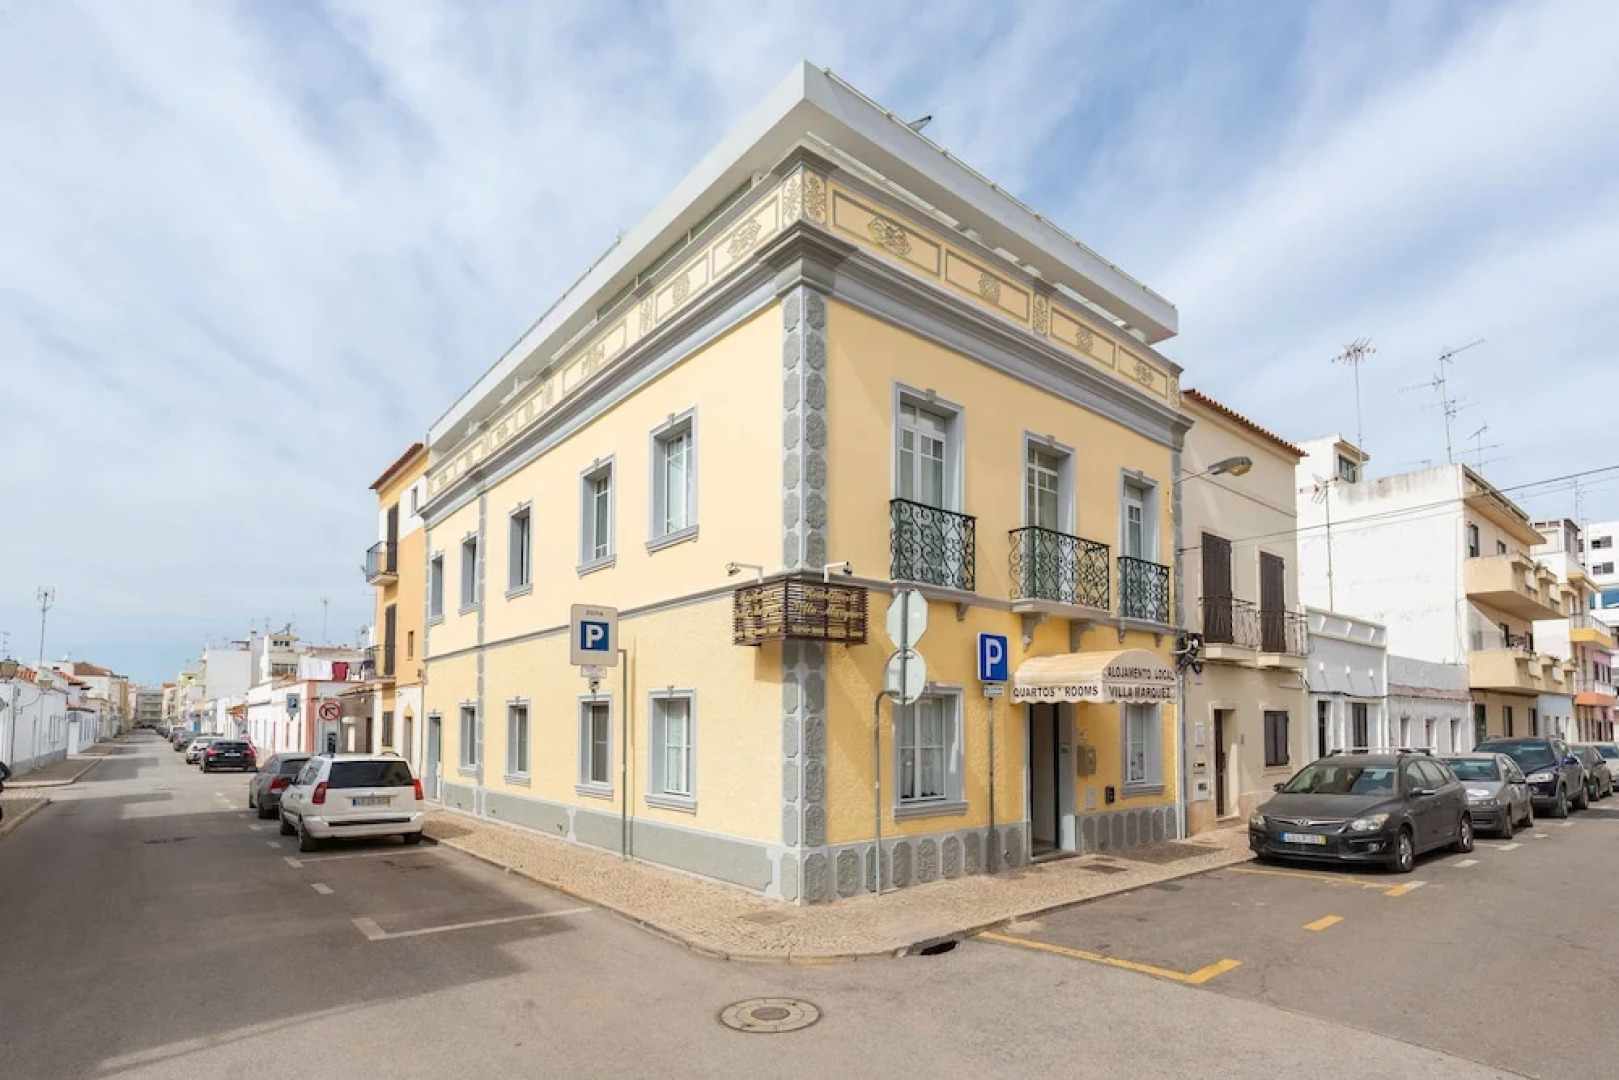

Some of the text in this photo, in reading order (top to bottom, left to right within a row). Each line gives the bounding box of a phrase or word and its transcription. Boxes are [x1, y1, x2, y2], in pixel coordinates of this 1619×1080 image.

[585, 624, 604, 648] P
[985, 637, 1003, 678] P
[1107, 666, 1175, 681] ALOJAMENTO LOCAL
[1013, 687, 1055, 697] QUARTOS
[1064, 685, 1099, 697] ROOMS
[1108, 686, 1133, 698] VILLA
